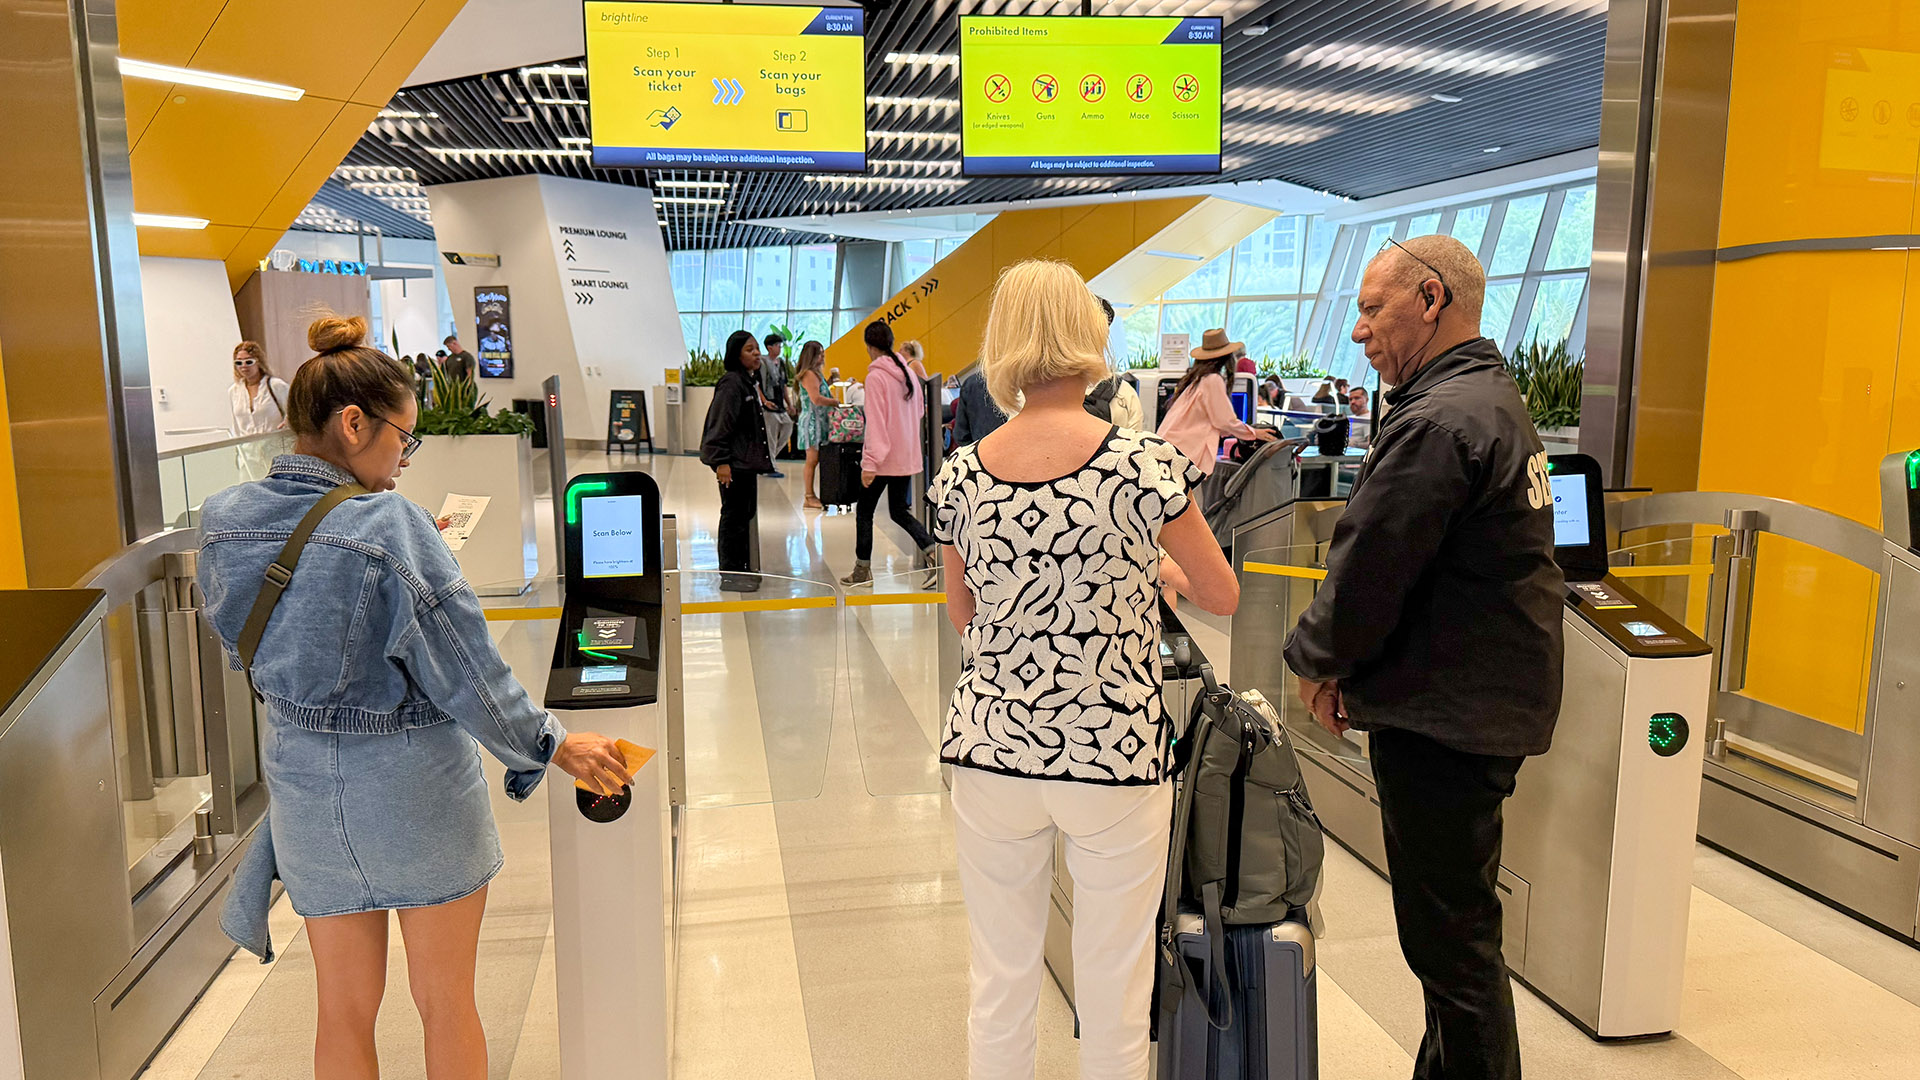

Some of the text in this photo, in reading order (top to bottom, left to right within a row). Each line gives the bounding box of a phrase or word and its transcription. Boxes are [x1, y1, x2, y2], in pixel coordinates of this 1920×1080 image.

[600, 12, 649, 26] brightline
[826, 23, 853, 32] 8:30 AM
[969, 26, 1048, 36] Prohibited Items
[646, 46, 680, 60] Step 1
[773, 49, 807, 64] Step 2
[633, 66, 696, 80] Scan your
[760, 69, 822, 83] Scan your
[648, 80, 682, 92] ticket
[776, 83, 806, 97] bags
[646, 152, 656, 161] All
[657, 153, 675, 163] bags
[675, 155, 692, 163] may
[692, 153, 703, 162] be
[703, 154, 729, 164] subject
[739, 155, 775, 163] additional
[1030, 161, 1039, 169] All
[1040, 161, 1053, 170] bags
[1074, 160, 1092, 169] subject
[559, 226, 627, 240] PREMIUM LOUNGE
[299, 258, 368, 276] MARY
[571, 279, 629, 289] SMART LOUNGE
